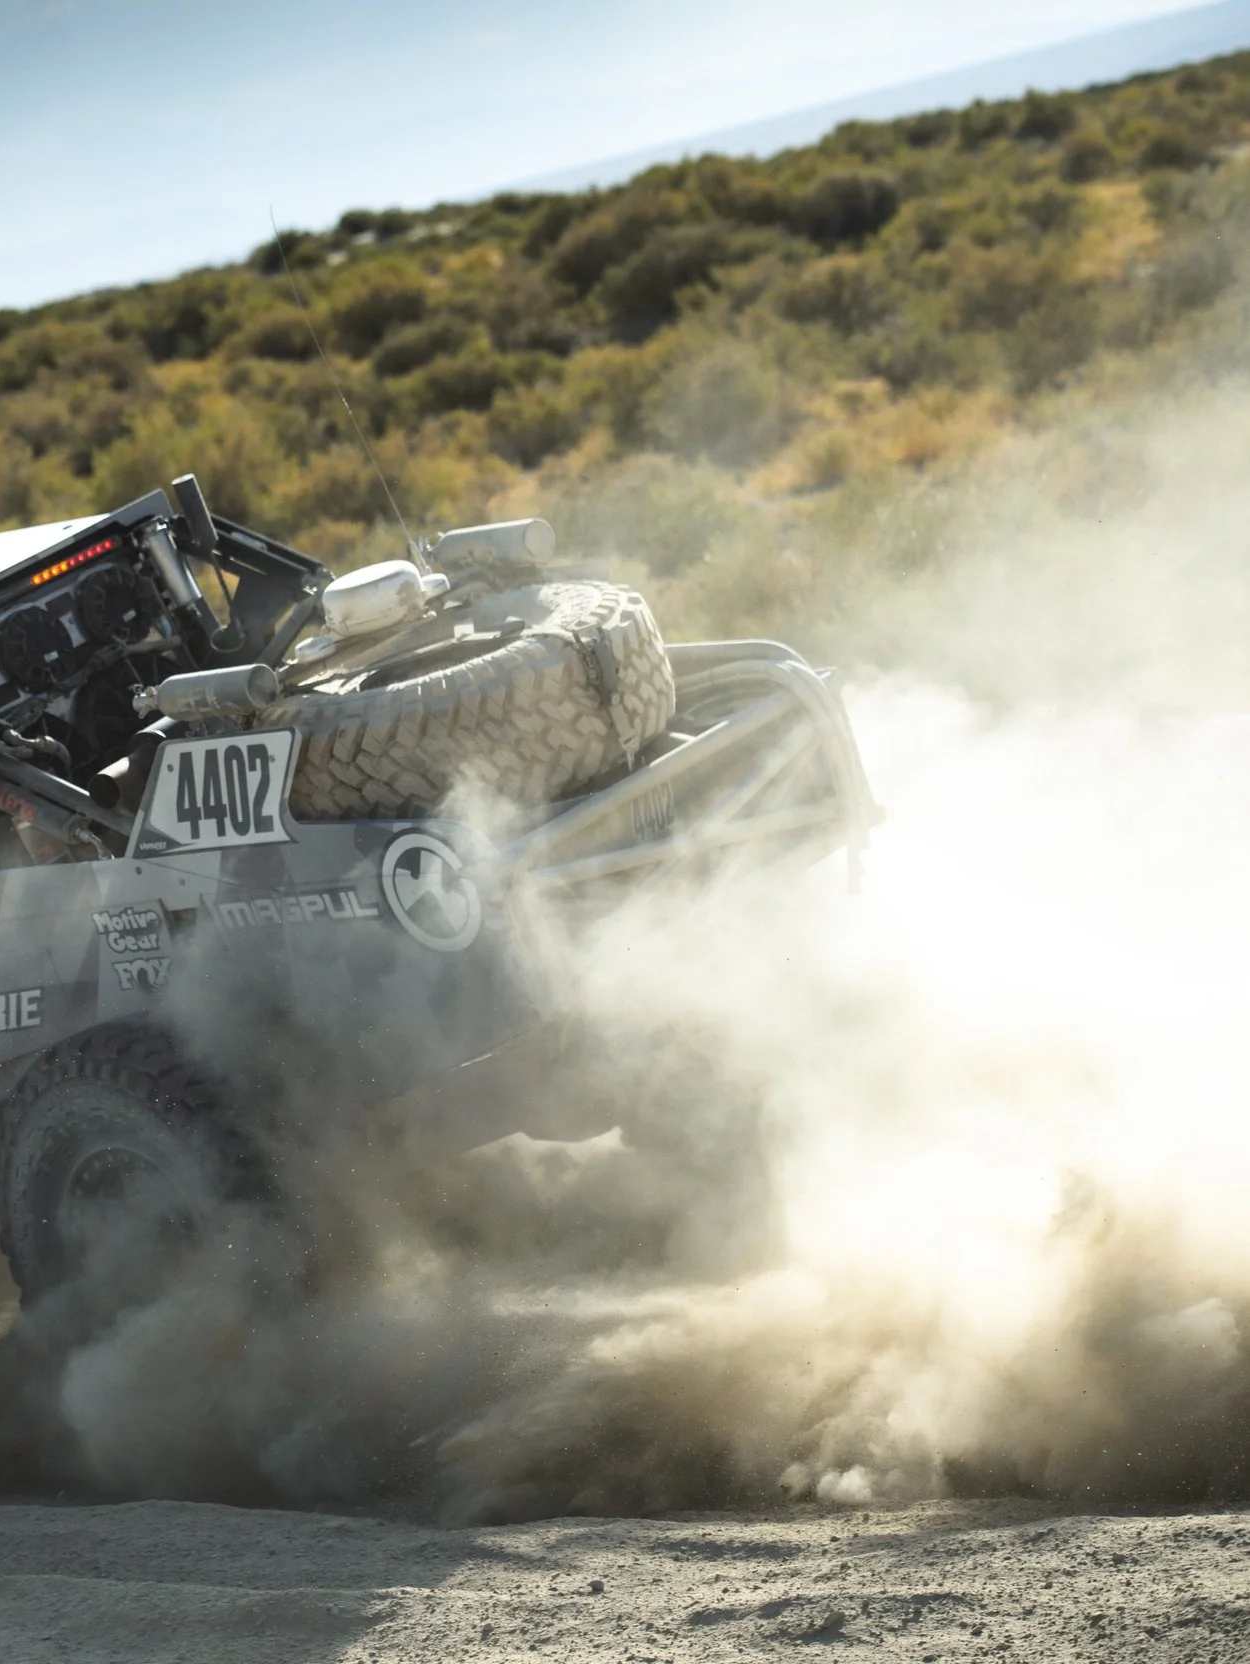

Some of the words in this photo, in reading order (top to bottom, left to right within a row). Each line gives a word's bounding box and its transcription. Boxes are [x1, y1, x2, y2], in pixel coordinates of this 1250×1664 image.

[176, 744, 275, 840] 4402
[92, 909, 159, 933] Motive
[218, 890, 379, 928] MAGPUL
[108, 931, 157, 953] Gear
[112, 958, 171, 993] FOX
